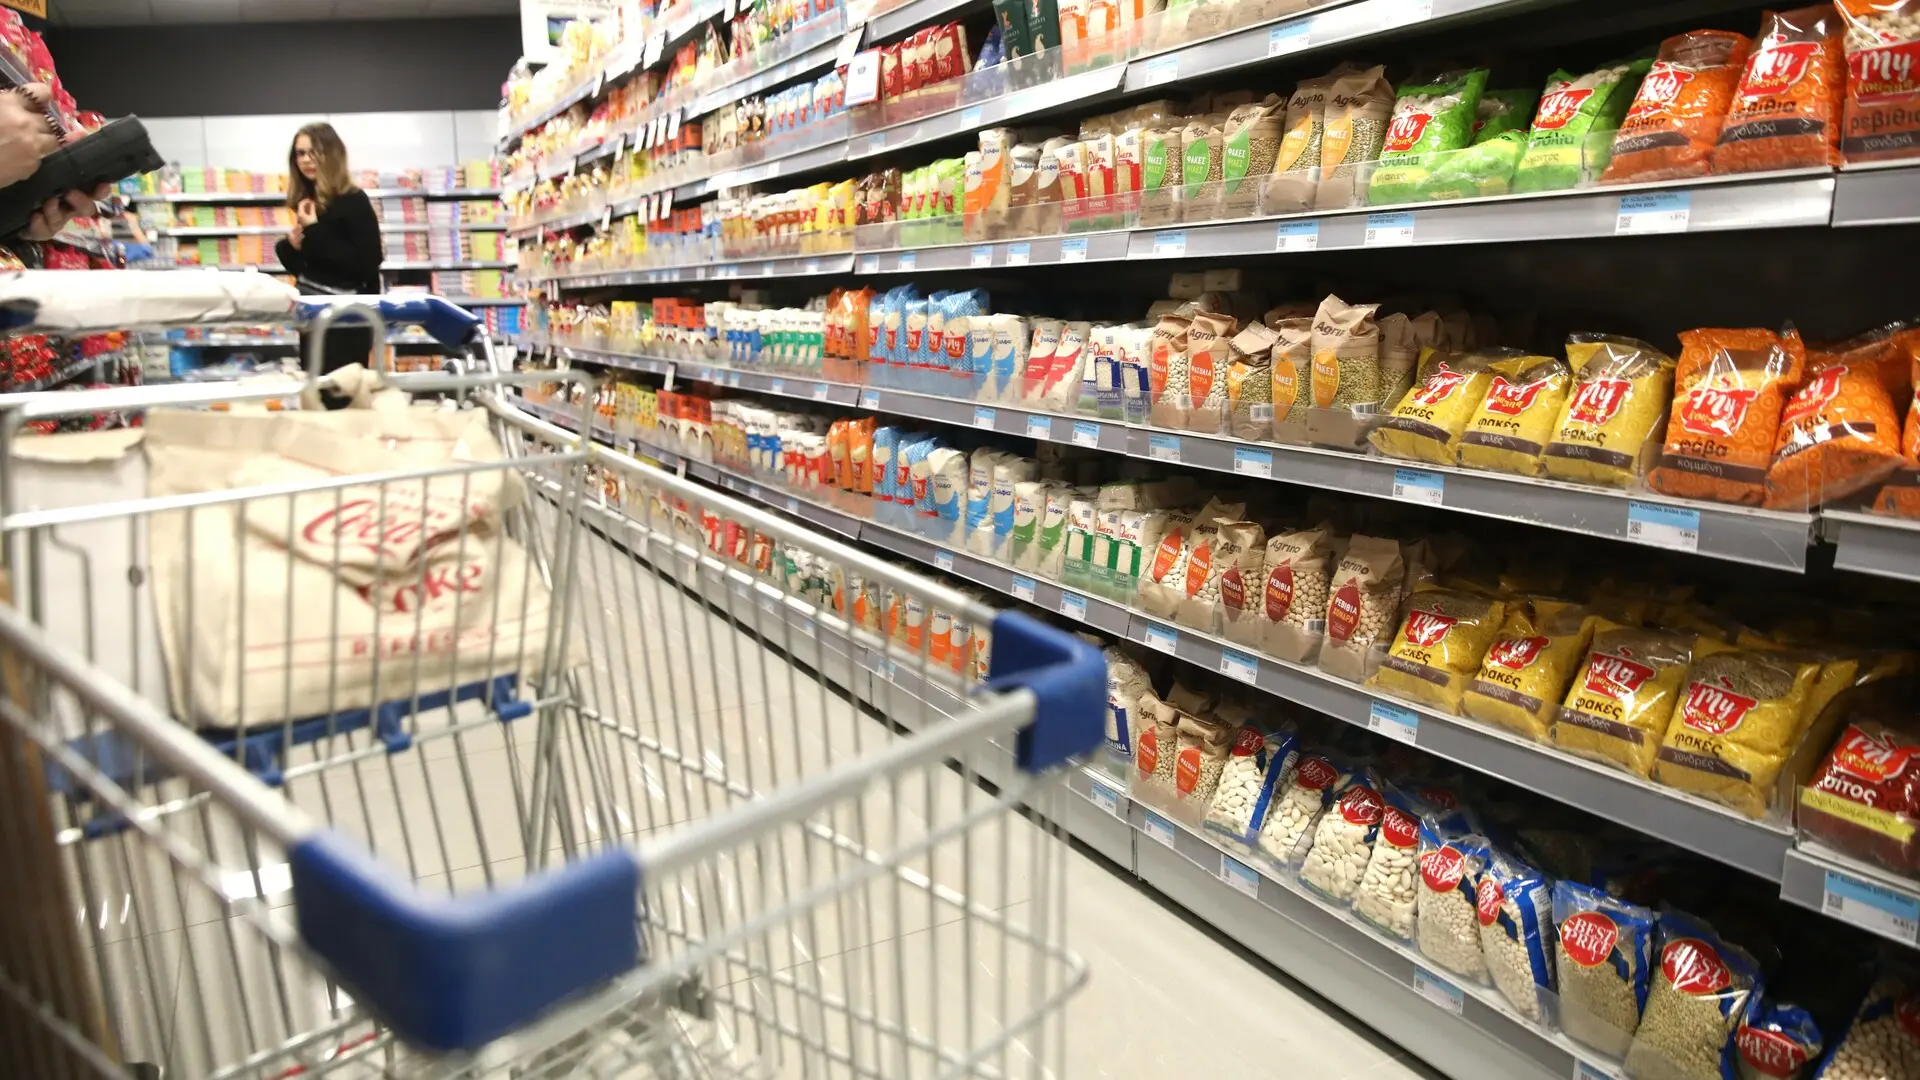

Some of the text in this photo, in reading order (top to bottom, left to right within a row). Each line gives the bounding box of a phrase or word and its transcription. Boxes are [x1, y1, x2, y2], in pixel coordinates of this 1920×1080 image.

[1861, 51, 1911, 82] My
[1187, 156, 1206, 165] ΦΑΚΕΣ
[1227, 148, 1246, 158] ΦΑΚΕΣ
[1190, 328, 1217, 341] Agrin
[1315, 321, 1346, 337] Agrin
[1398, 405, 1434, 420] φακές
[1677, 459, 1723, 475] κομμένη
[1270, 539, 1301, 554] Agrino
[1222, 578, 1242, 592] ΡΕΒΙΘΙΑ
[1270, 577, 1291, 593] ΡΕΒΙΘΙΑ
[1335, 597, 1358, 615] ΡΕΒΙΘΙΑ
[1575, 696, 1622, 720] φακές
[1694, 688, 1737, 720] My
[1674, 733, 1722, 758] φακές
[1673, 751, 1714, 770] χονδρές
[1823, 775, 1877, 808] σίτος
[1384, 814, 1420, 840] PRICE
[1571, 918, 1616, 944] BEST
[1564, 925, 1612, 957] PRICE
